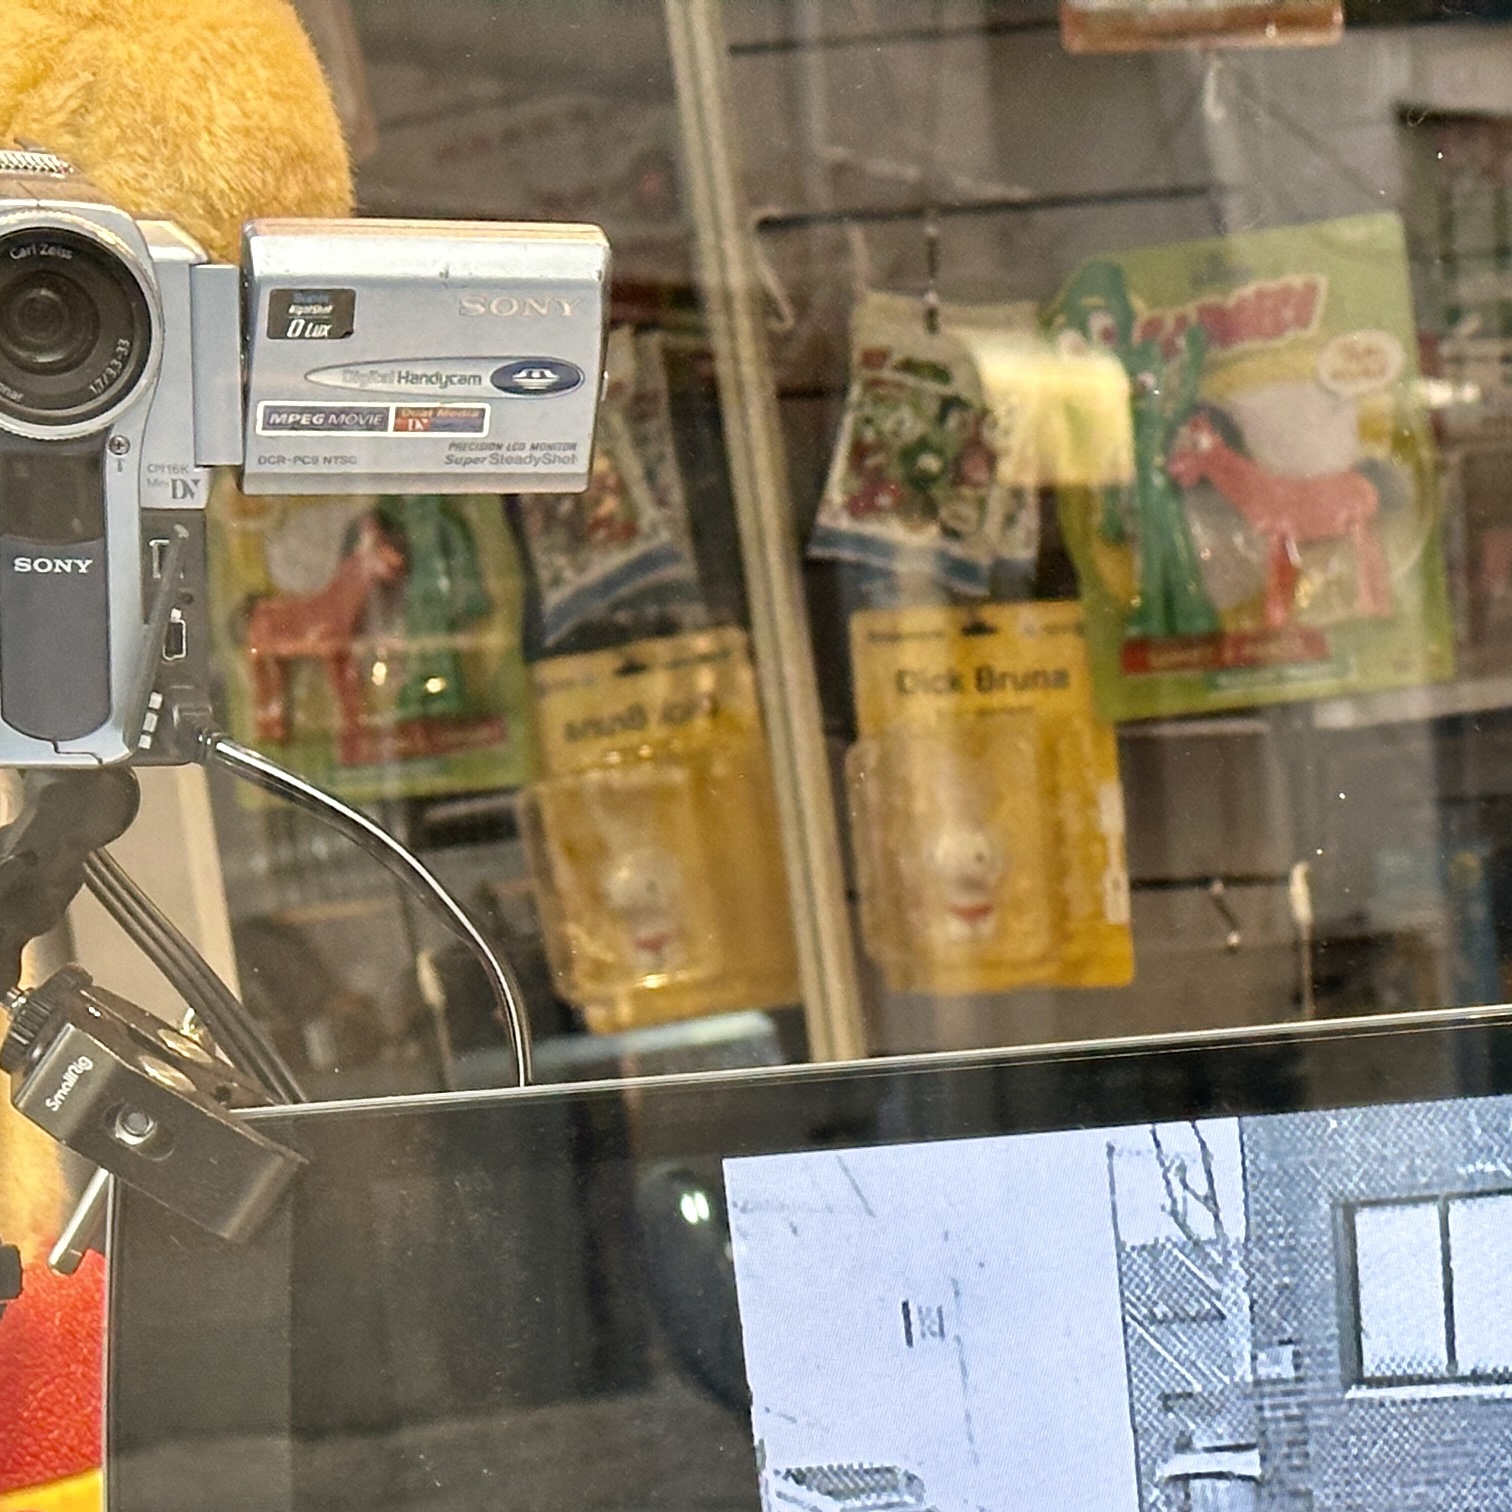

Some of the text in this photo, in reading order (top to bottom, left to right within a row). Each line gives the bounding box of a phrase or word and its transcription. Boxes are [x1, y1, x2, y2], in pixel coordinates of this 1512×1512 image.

[9, 243, 73, 260] Carl Zeiss
[458, 295, 580, 318] SONY
[397, 369, 483, 389] Handycam
[268, 412, 384, 427] MPEG MOVIE
[448, 442, 578, 452] PRECISION LCD MONITOR
[322, 455, 359, 466] NTSC
[444, 452, 579, 468] Super SteadyShot
[13, 556, 94, 574] SONY
